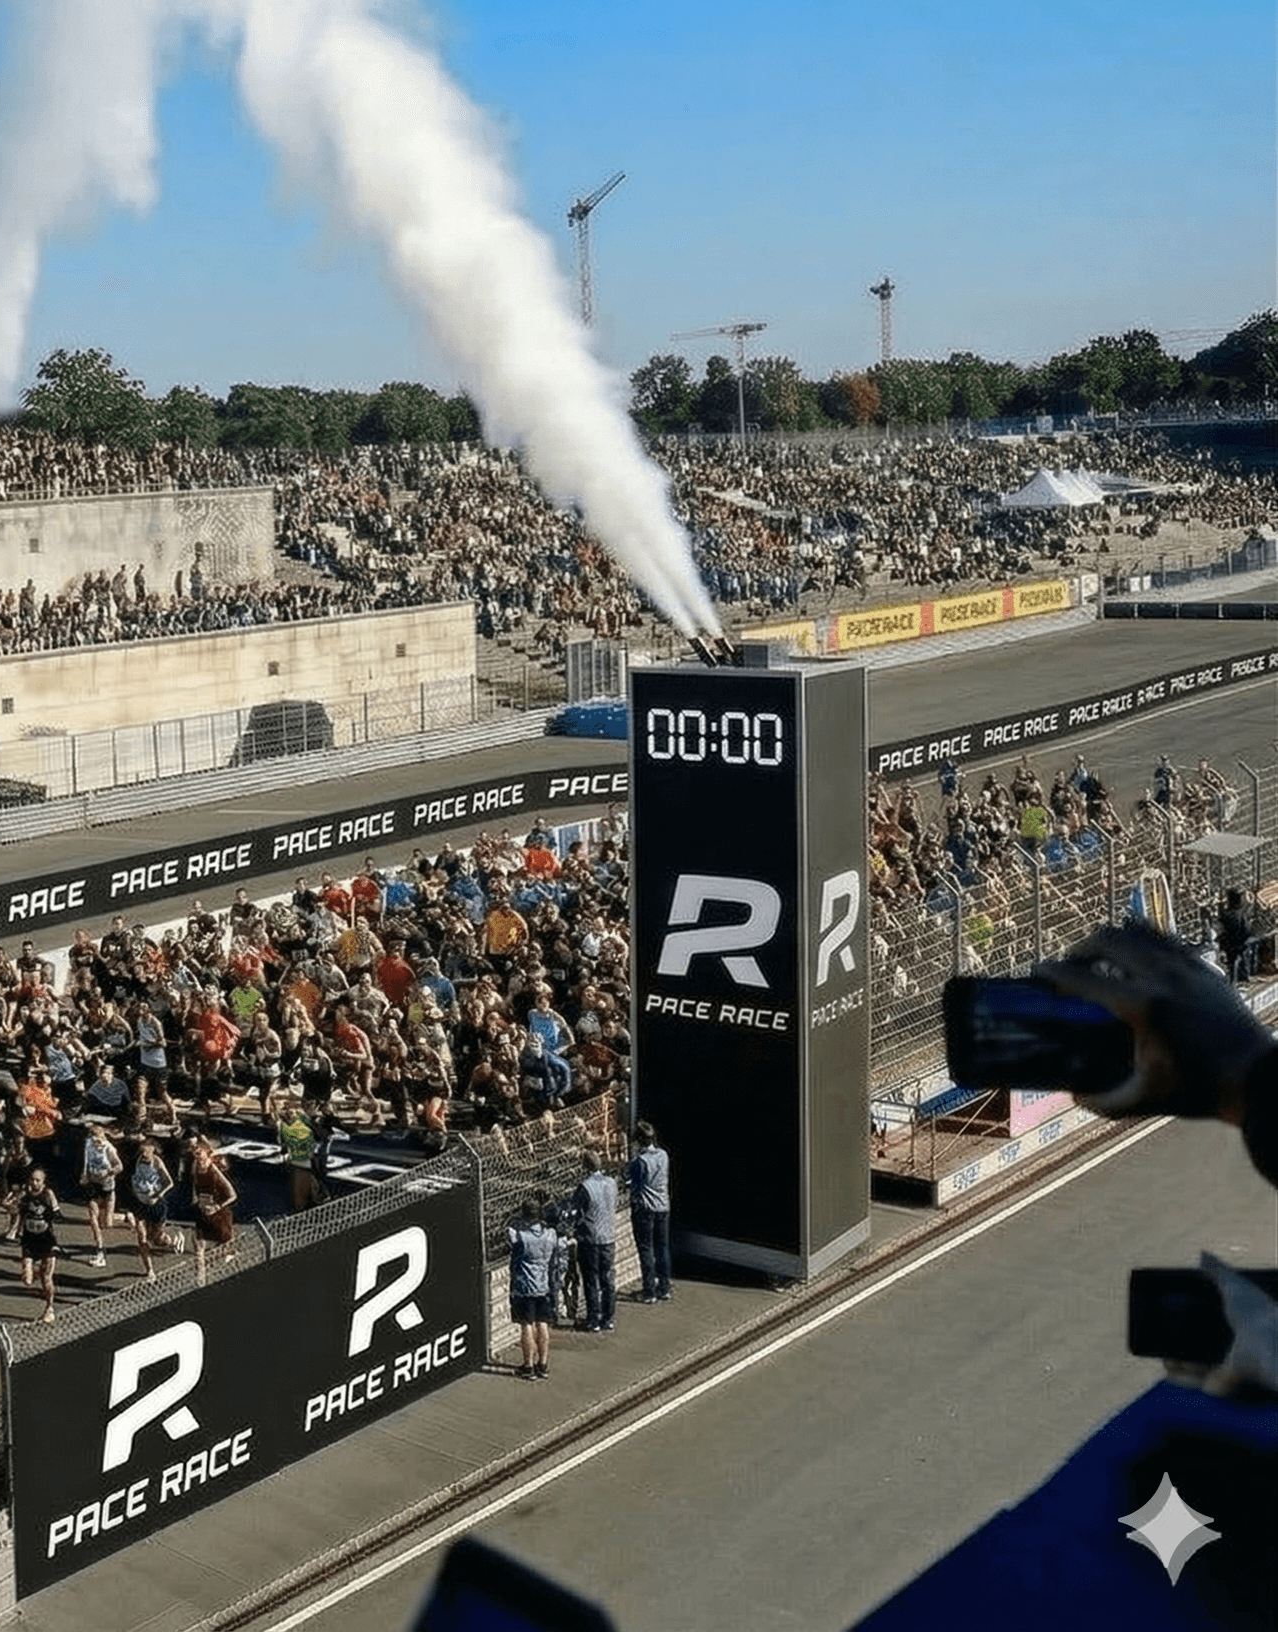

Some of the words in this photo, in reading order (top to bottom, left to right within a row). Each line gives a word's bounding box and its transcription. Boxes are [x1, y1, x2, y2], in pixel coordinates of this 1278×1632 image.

[648, 709, 781, 765] 00:00
[984, 723, 1020, 747] PACE
[1024, 713, 1058, 736] RACE
[880, 746, 923, 773] PACE
[928, 734, 972, 762] RACE
[415, 796, 467, 825] PACE
[473, 784, 523, 813] RACE
[549, 774, 627, 797] PACE
[274, 826, 332, 859] PACE
[339, 811, 394, 843] RACE
[111, 860, 178, 896] PACE
[187, 844, 251, 879] RACE
[9, 881, 85, 921] RACE
[646, 995, 711, 1019] PACE
[720, 1005, 789, 1030] RACE
[305, 1365, 385, 1431] PACE
[394, 1325, 467, 1387] RACE
[49, 1478, 149, 1557] PACE
[160, 1429, 251, 1502] RACE
